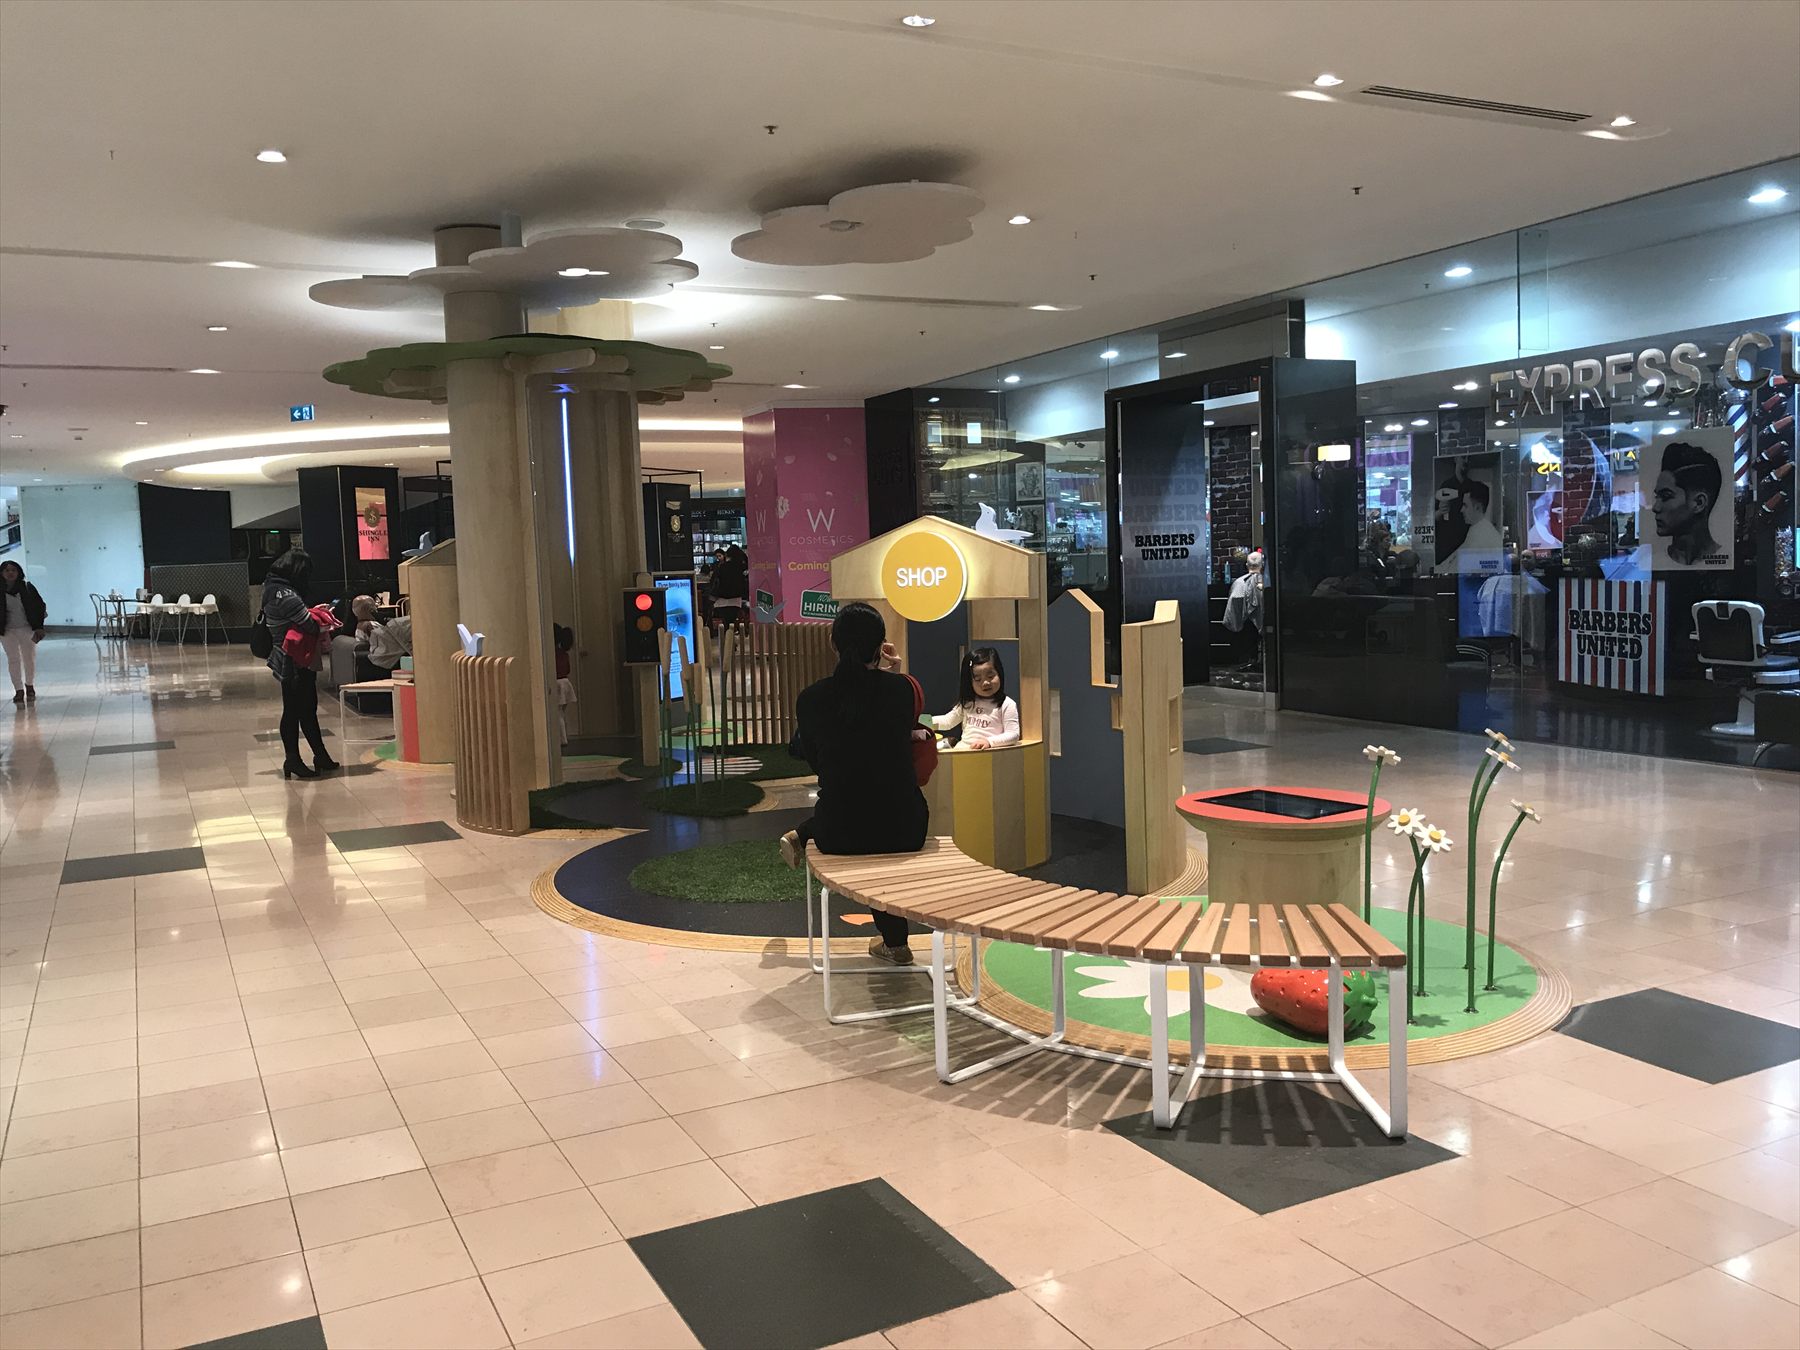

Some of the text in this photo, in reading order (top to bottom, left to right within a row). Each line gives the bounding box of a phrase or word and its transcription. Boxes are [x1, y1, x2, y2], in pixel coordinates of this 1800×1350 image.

[1490, 342, 1701, 417] EXPRESS
[806, 508, 835, 533] W
[789, 535, 854, 546] COSMETICS
[1134, 534, 1195, 548] BARBERS
[1141, 547, 1190, 561] UNITED
[788, 561, 832, 572] Coming
[896, 566, 947, 588] SHOP
[1568, 608, 1652, 636] BARBERS
[1576, 633, 1644, 660] UNITED
